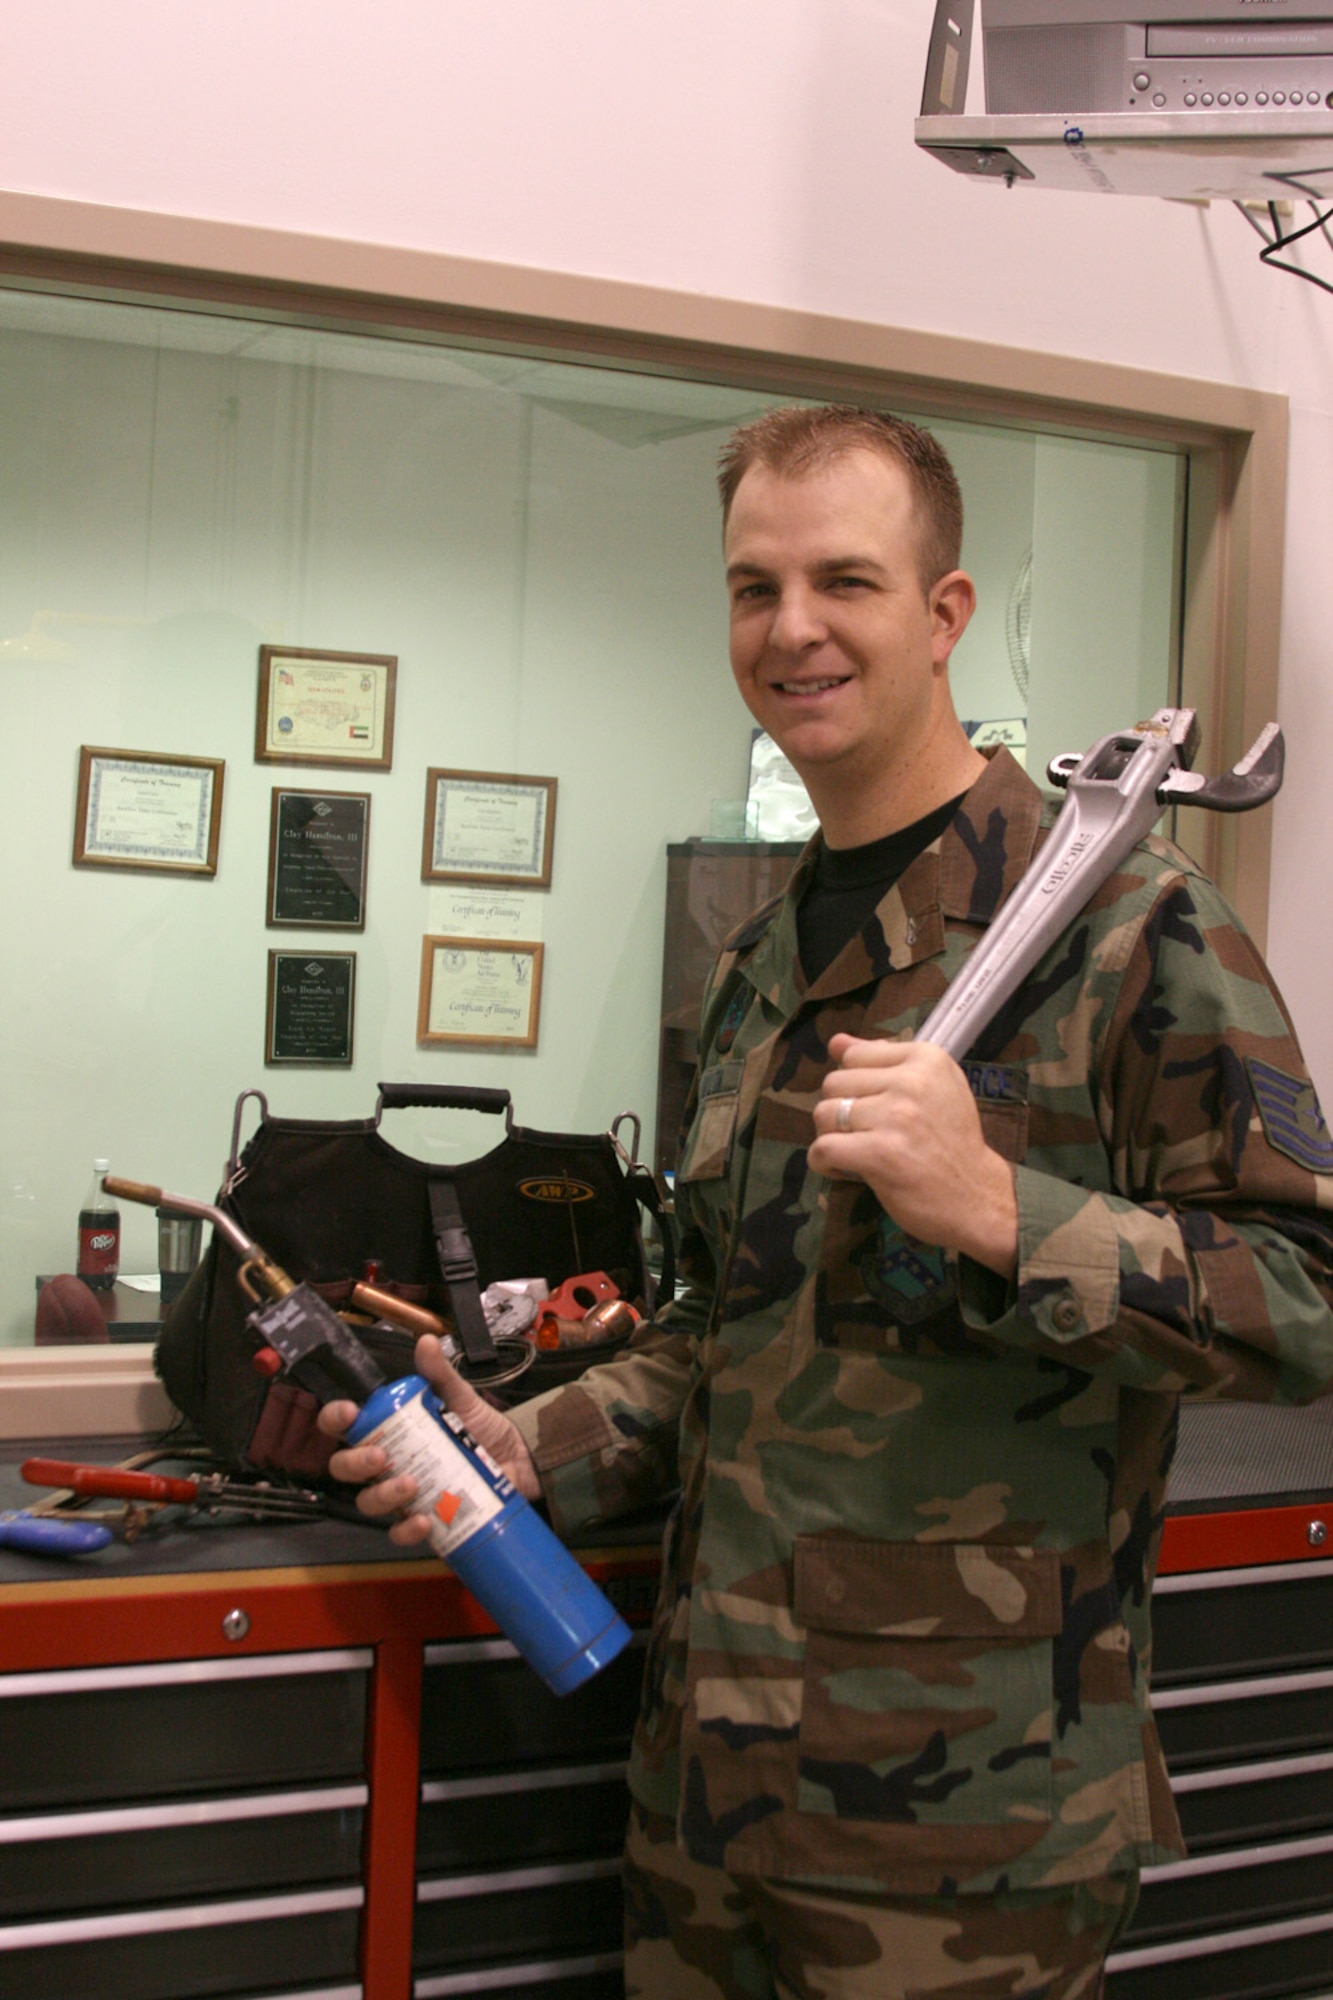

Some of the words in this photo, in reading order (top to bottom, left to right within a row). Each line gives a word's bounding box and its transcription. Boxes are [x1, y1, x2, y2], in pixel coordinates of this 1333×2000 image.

[283, 828, 302, 840] Clay
[452, 904, 486, 919] Certificate
[493, 906, 521, 922] Training
[449, 1000, 485, 1016] Certificate
[493, 1003, 521, 1020] Training
[963, 1064, 1013, 1100] RCE
